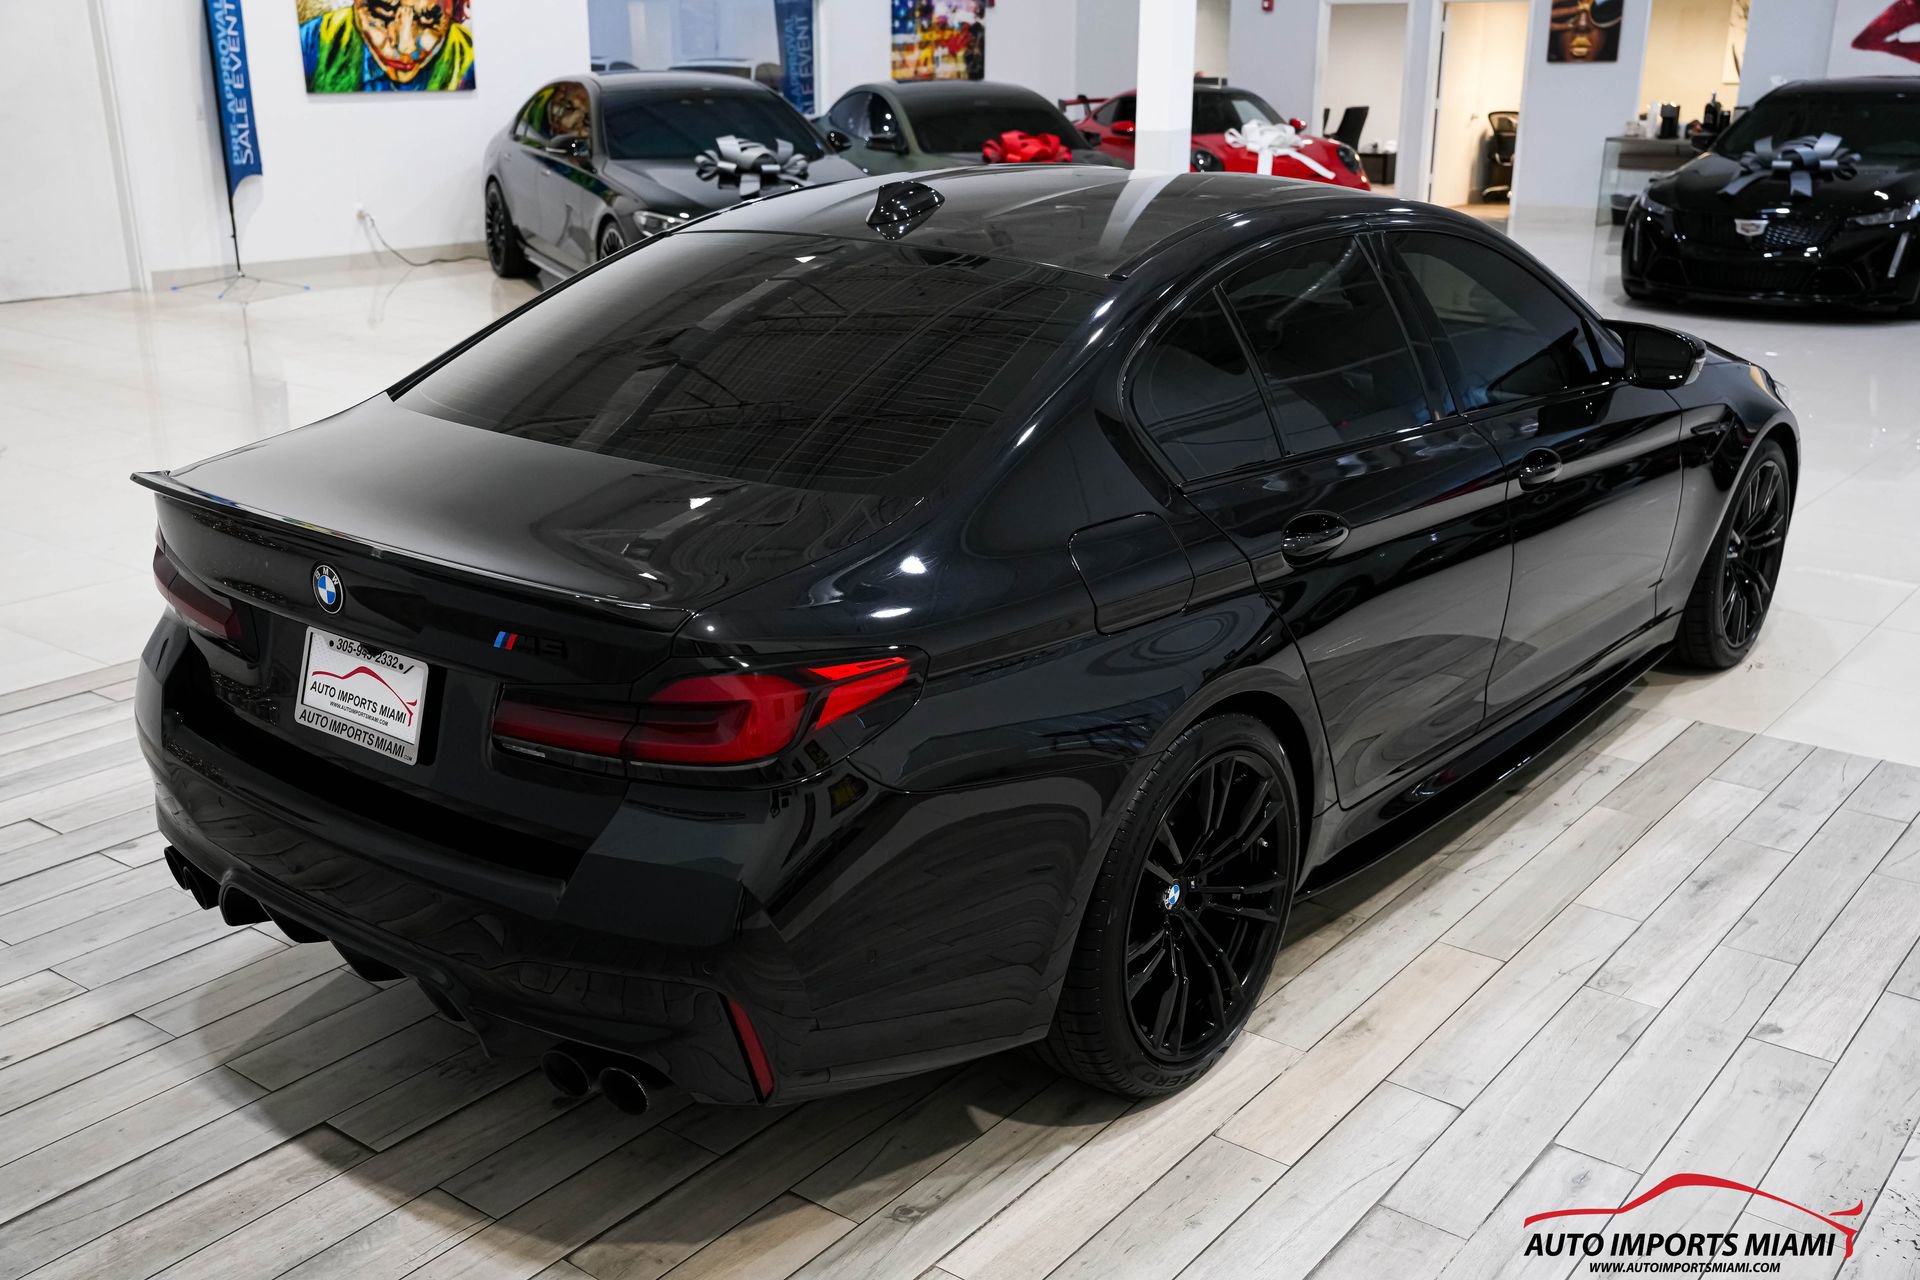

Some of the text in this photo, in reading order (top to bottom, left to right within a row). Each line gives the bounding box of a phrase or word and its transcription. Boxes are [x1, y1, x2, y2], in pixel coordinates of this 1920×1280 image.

[797, 16, 812, 77] EVENT
[213, 0, 244, 165] PRE-APPROVAL
[224, 0, 254, 165] SALE EVENT
[314, 567, 339, 585] BMW
[299, 709, 329, 728] AUTO
[329, 719, 375, 746] IMPORTS
[310, 681, 407, 724] AUTO IMPORTS MIAMI
